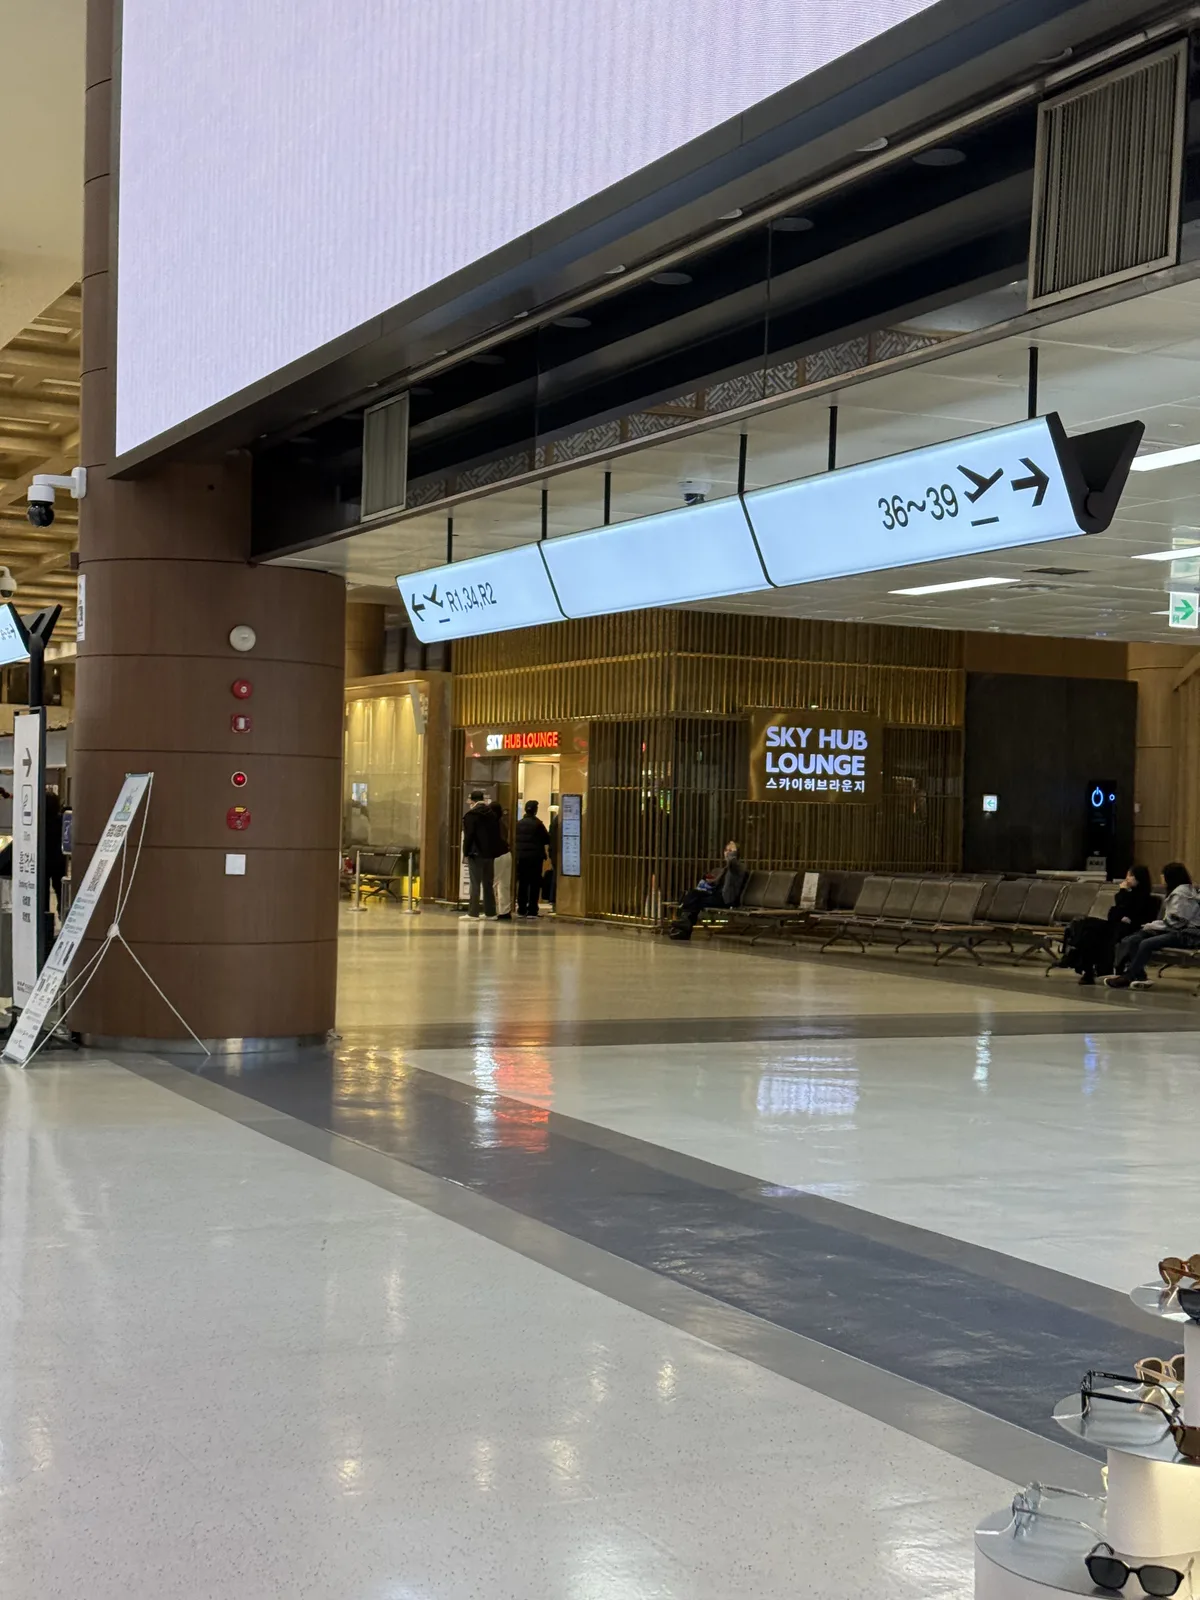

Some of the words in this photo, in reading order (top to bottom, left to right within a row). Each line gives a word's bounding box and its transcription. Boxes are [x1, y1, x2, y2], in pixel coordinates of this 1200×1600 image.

[878, 483, 959, 531] 36~39
[445, 581, 498, 613] R1,34,R2
[486, 734, 503, 751] SKY
[504, 733, 522, 749] HUB
[523, 731, 558, 749] LOUNGE
[766, 726, 813, 748] SKY
[818, 728, 868, 751] HUB
[766, 752, 866, 776] LOUNGE
[766, 777, 865, 793] 스카이허브라운지
